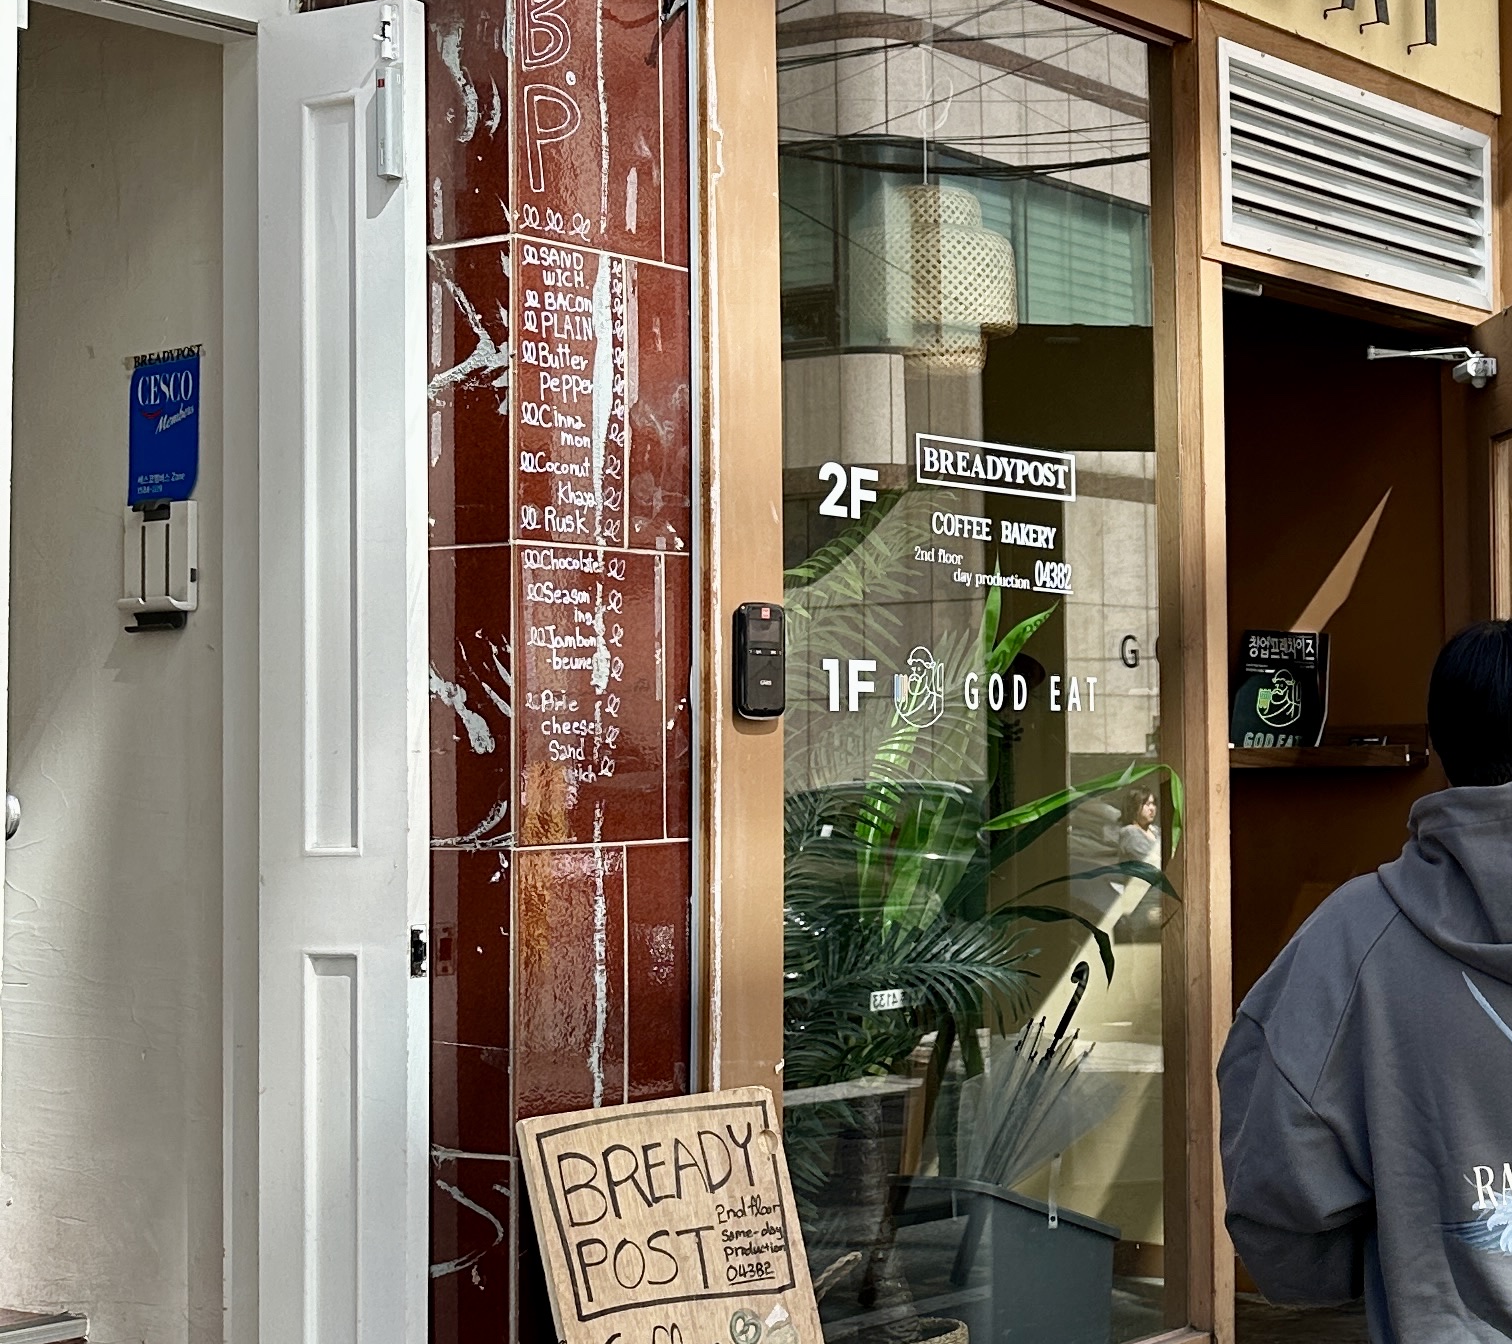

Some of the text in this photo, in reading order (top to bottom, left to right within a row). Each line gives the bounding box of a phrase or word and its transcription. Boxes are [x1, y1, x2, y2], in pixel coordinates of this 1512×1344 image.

[539, 246, 584, 271] SAND
[541, 311, 593, 341] PLAIN
[134, 343, 202, 369] BREADYPOST
[538, 342, 589, 372] Butter
[137, 370, 193, 406] CESCO
[560, 430, 591, 449] mon
[535, 452, 590, 478] Coconut
[923, 446, 1069, 490] BREADYPOST
[818, 461, 879, 519] 2F
[544, 506, 590, 535] Rusk
[931, 511, 1057, 549] COFFEE BAKERY
[914, 545, 963, 566] 2nd floor
[953, 559, 1073, 591] day production 04382
[822, 658, 877, 713] 1F
[964, 673, 1098, 713] GOD EAT
[557, 1122, 757, 1227] BREADY
[576, 1226, 714, 1302] POST
